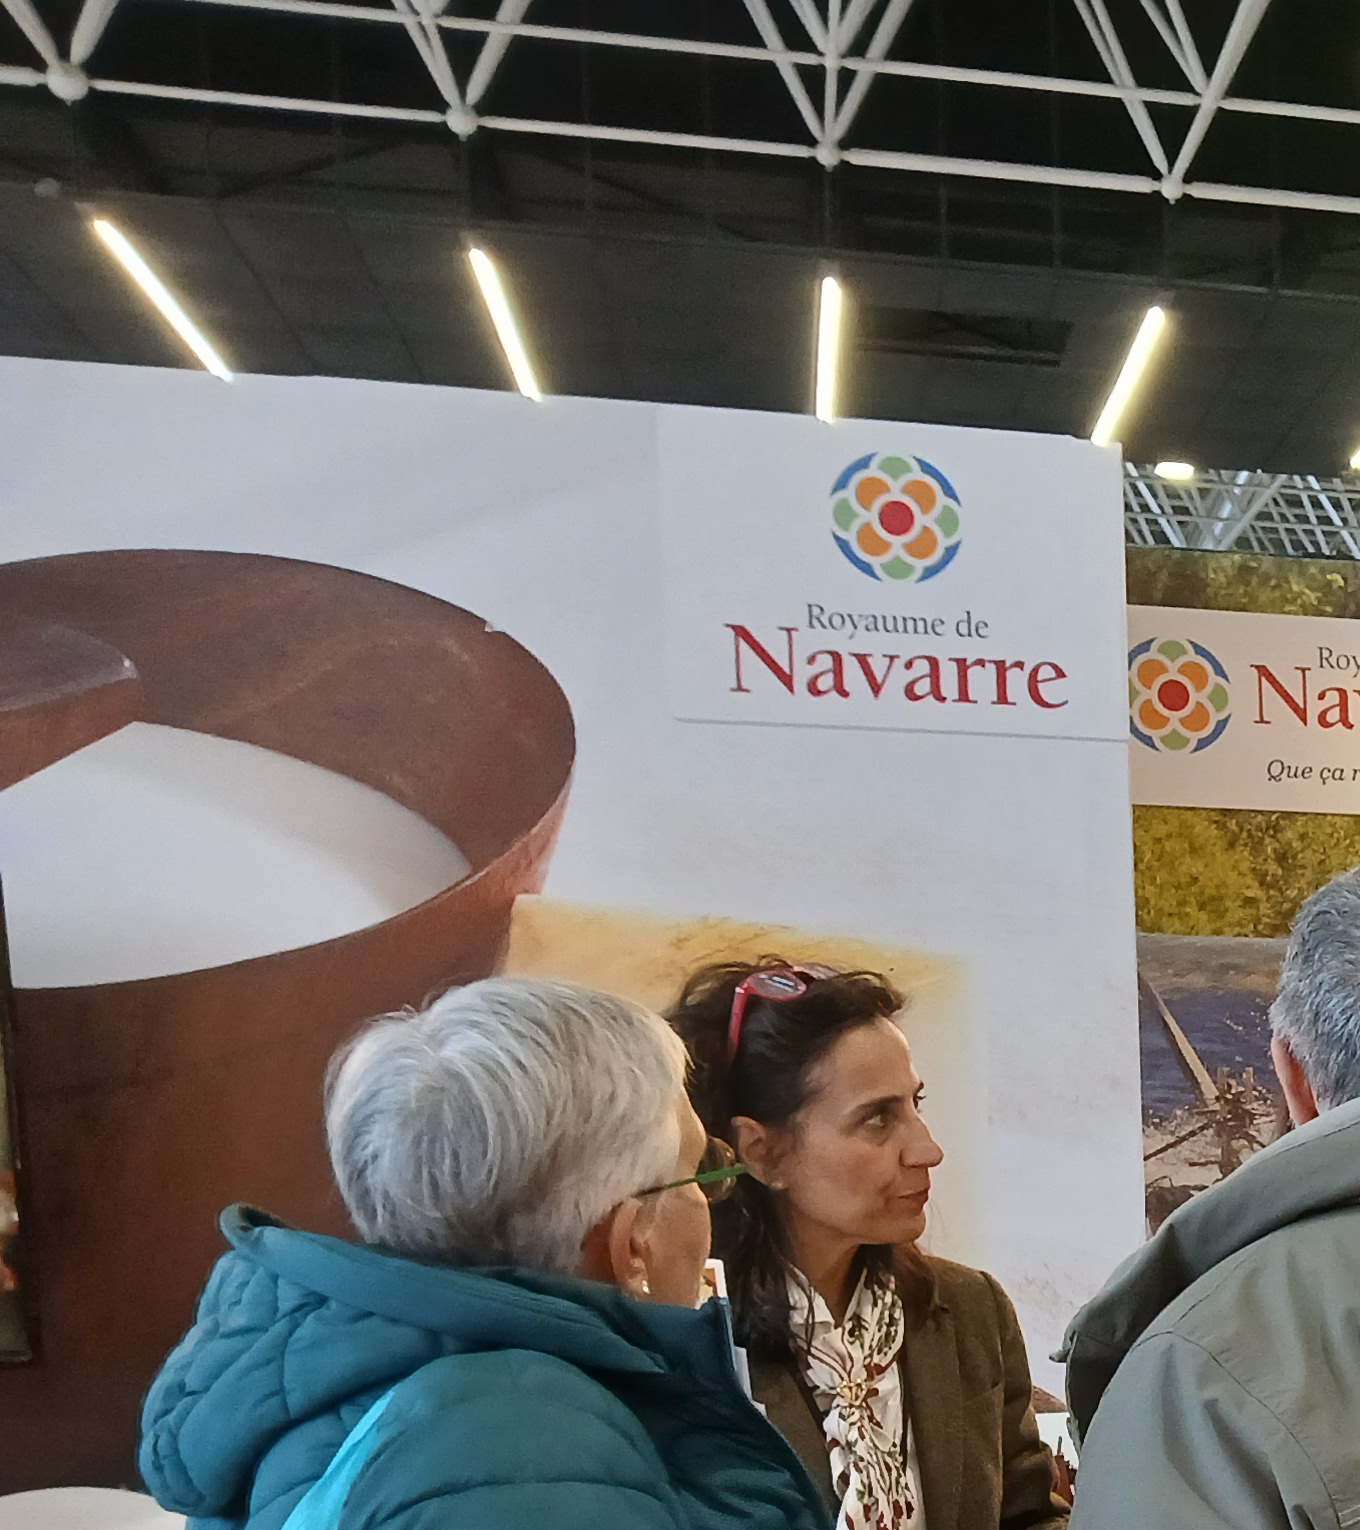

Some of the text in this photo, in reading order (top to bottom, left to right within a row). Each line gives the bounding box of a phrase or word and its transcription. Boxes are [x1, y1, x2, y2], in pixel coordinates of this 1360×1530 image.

[806, 602, 990, 640] Royaume de
[723, 623, 1069, 709] Navarre
[1267, 759, 1313, 782] Que
[1319, 766, 1345, 785] ça
